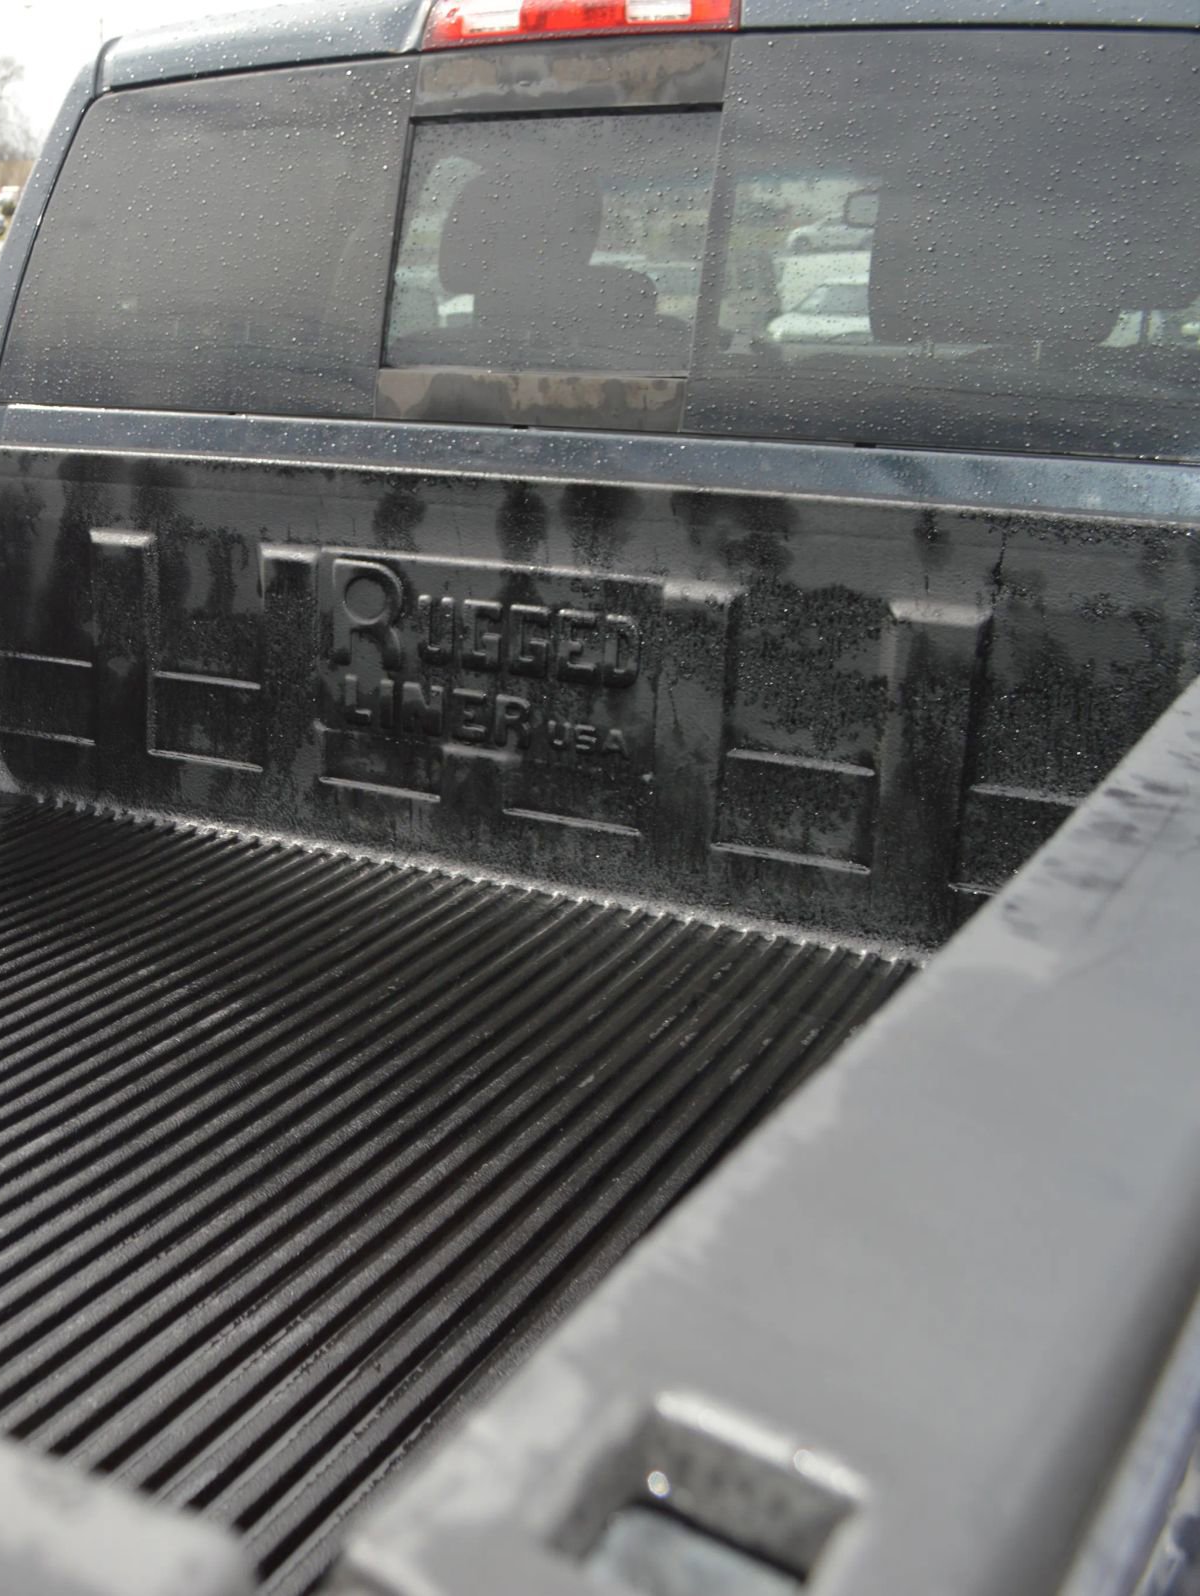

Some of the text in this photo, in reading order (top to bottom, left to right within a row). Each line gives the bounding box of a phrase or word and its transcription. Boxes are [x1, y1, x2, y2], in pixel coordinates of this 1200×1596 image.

[331, 557, 643, 689] RUGGED
[344, 673, 630, 759] LINER USA
